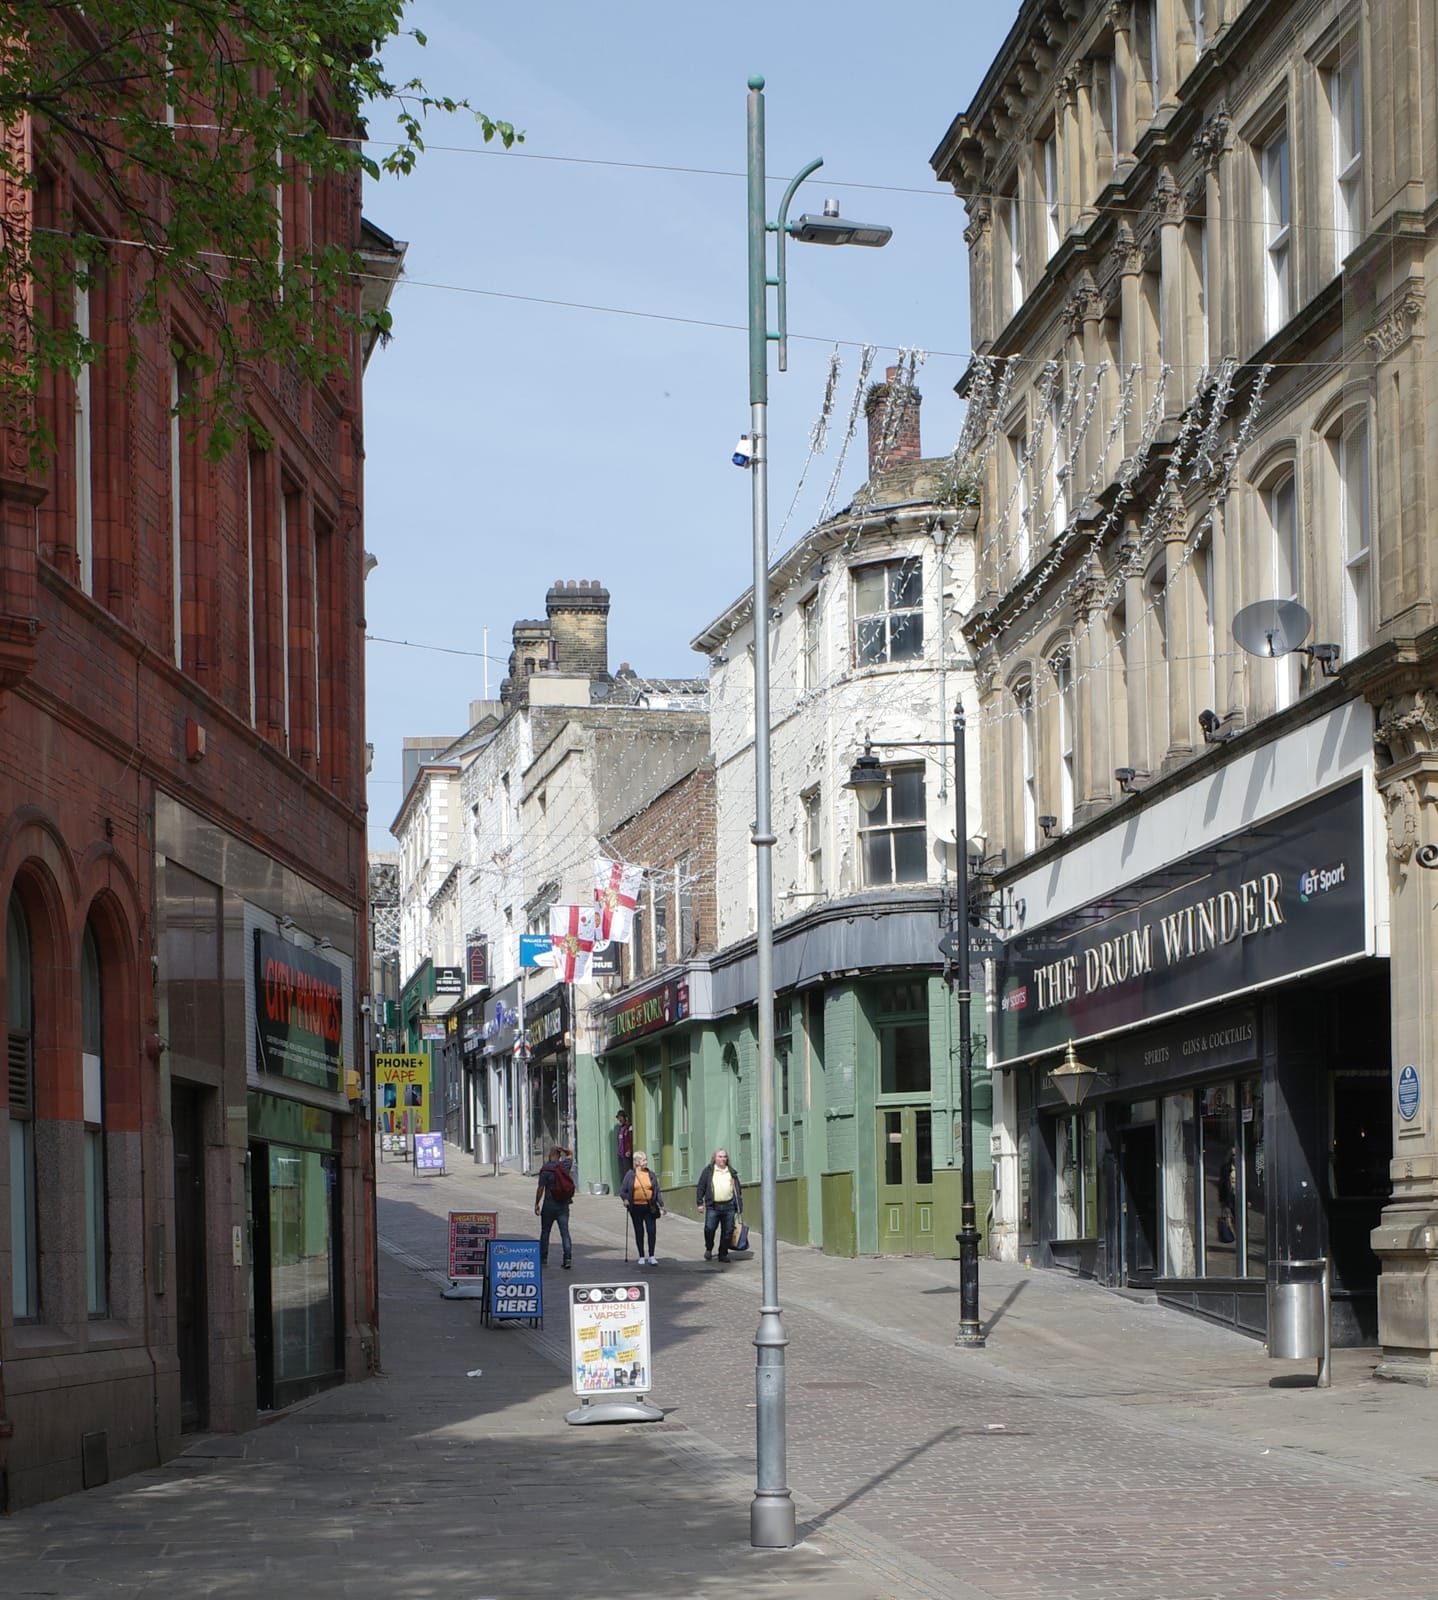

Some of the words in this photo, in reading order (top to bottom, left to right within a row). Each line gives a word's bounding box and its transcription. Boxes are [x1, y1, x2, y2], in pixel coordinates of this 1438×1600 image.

[1305, 874, 1319, 895] BT
[1320, 862, 1345, 891] Sport
[951, 944, 994, 952] WDER
[1033, 955, 1078, 1011] THE
[1084, 924, 1154, 994] DRUM
[1160, 872, 1286, 966] WINDER
[470, 944, 485, 984] APE
[592, 961, 614, 969] NUE
[265, 955, 294, 1025] CITY
[296, 968, 341, 1044] PHONES
[1001, 995, 1010, 1012] sky
[1009, 990, 1026, 1009] sports
[616, 1007, 636, 1036] DUKE
[643, 994, 663, 1025] YORK
[1143, 1046, 1170, 1066] SPIRITS
[1182, 1038, 1201, 1056] GINS
[1201, 1037, 1208, 1050] &
[1208, 1023, 1252, 1049] COCKTAILS
[376, 1058, 424, 1069] PHONE+
[384, 1070, 417, 1083] VAPE
[496, 1261, 535, 1271] VAPING
[496, 1270, 535, 1279] PRODUCTS
[495, 1284, 537, 1298] SOLD
[496, 1300, 537, 1313] HERE
[582, 1303, 602, 1311] CITY
[602, 1303, 636, 1311] PHONES
[593, 1311, 626, 1320] VAPES
